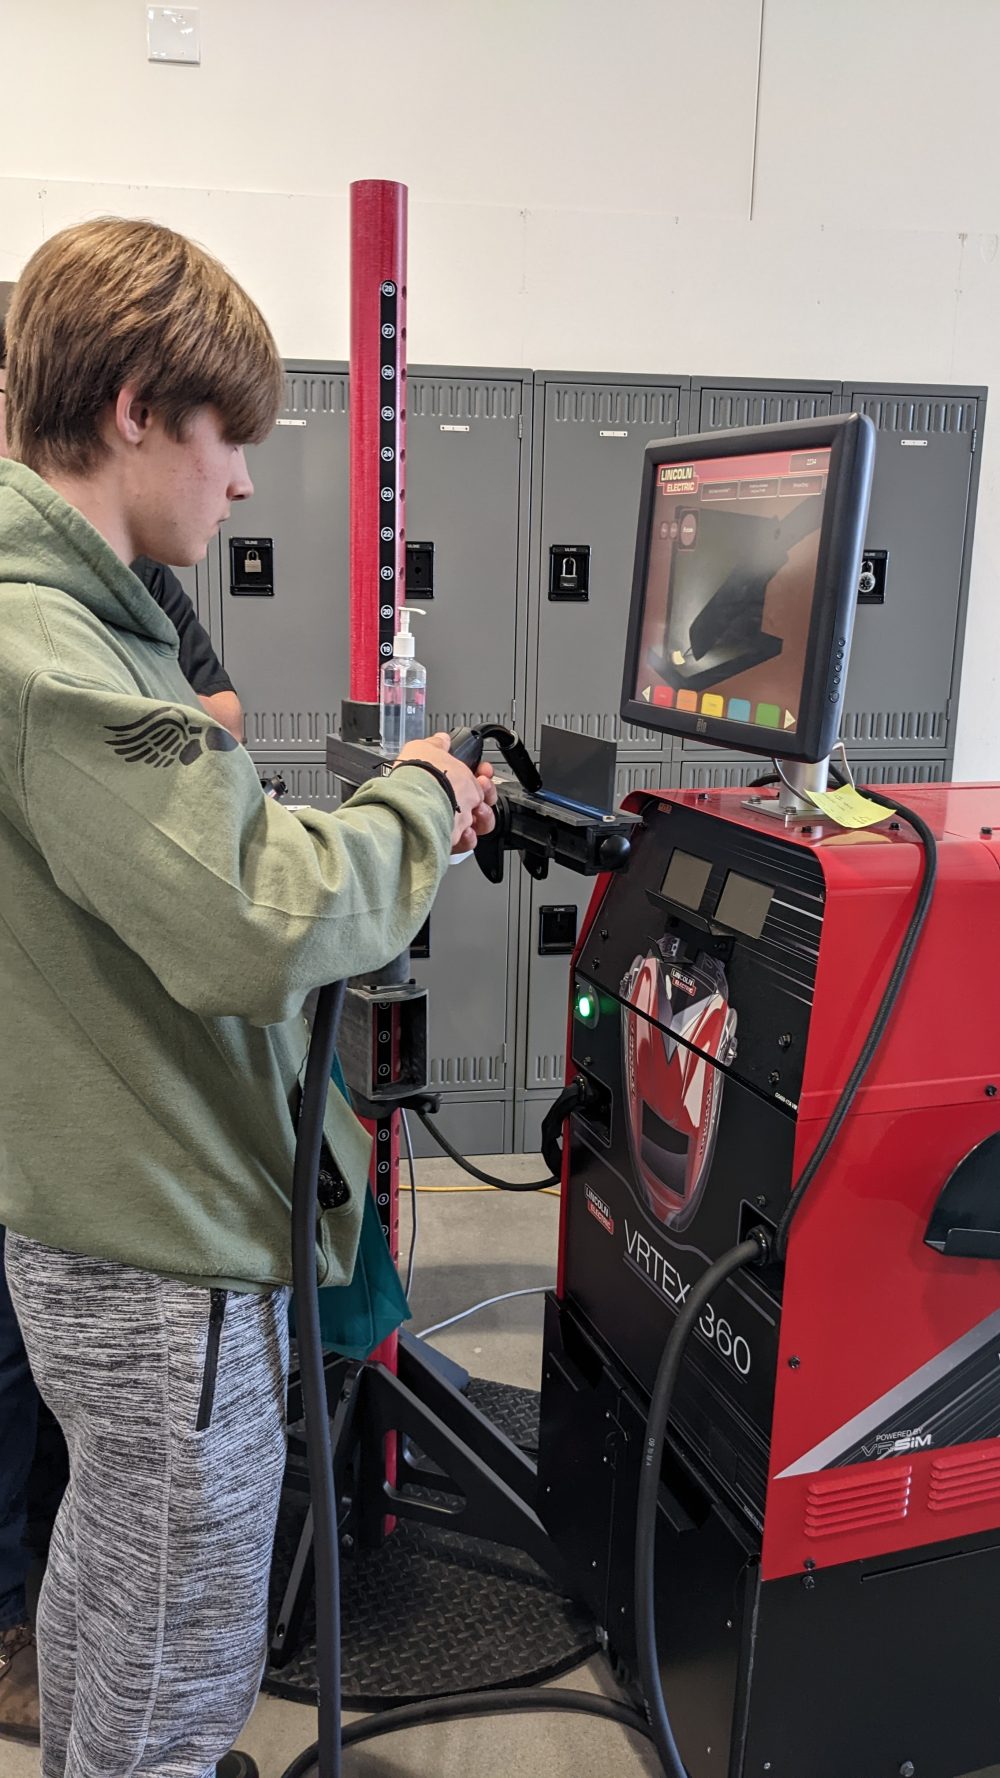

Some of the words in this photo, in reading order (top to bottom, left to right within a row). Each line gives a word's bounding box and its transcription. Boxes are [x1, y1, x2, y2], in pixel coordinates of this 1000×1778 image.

[661, 467, 693, 481] LINCOLN
[666, 482, 694, 492] ELECTRIC
[672, 970, 694, 986] LINCOLN
[586, 1187, 610, 1218] LINCOLN
[590, 1202, 612, 1230] ELECTRIC
[624, 1218, 690, 1304] VRTEX
[700, 1302, 750, 1375] 360
[876, 1430, 912, 1442] POWERED
[912, 1426, 923, 1436] BY
